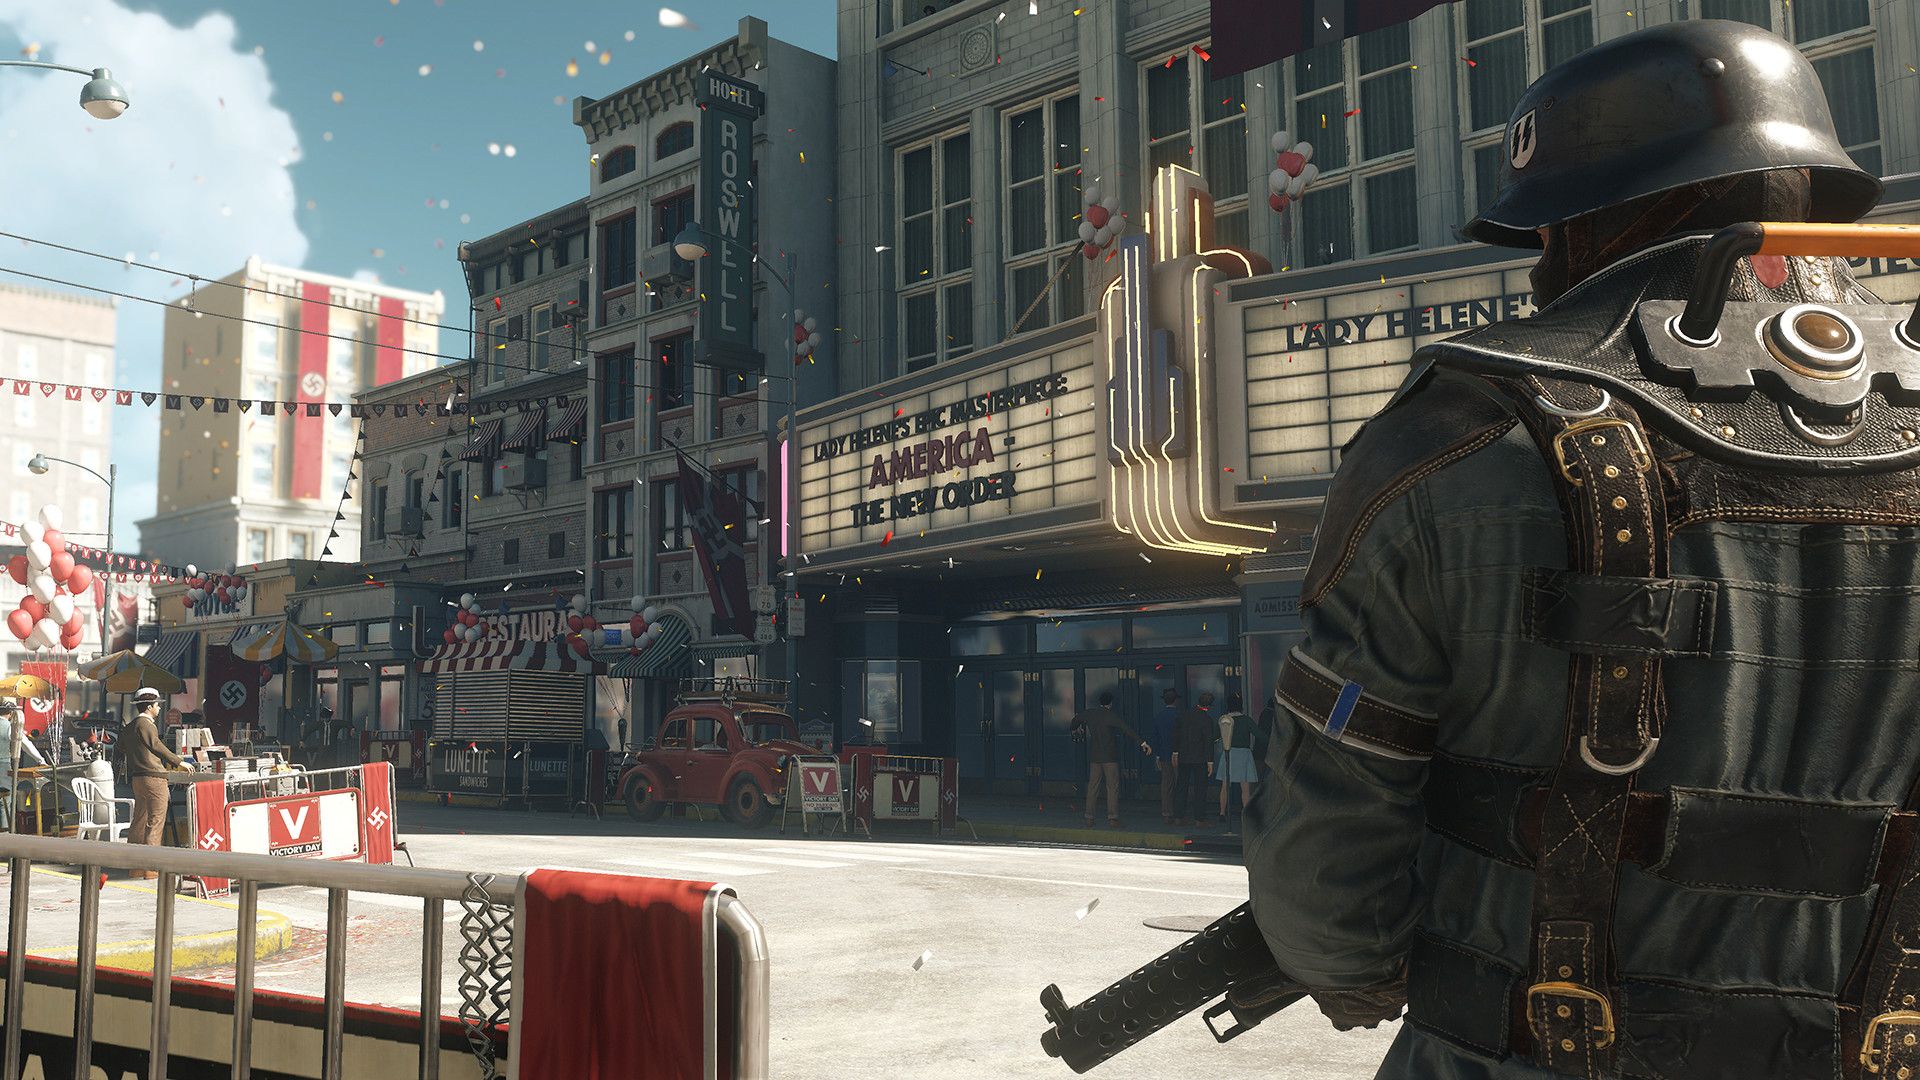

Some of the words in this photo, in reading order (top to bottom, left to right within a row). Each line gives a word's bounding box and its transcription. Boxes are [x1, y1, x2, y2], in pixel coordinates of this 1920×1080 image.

[709, 78, 754, 109] HOTEL
[717, 119, 740, 332] ROSWELL
[1286, 314, 1376, 351] LADY
[18, 383, 27, 393] V
[69, 388, 79, 398] V
[119, 394, 128, 404] V
[813, 434, 851, 463] LADY
[850, 416, 911, 452] HELENE'S
[914, 406, 947, 435] EPIC
[950, 373, 1068, 423] MASTERPIECE
[869, 427, 995, 490] AMERICA
[851, 498, 885, 528] THE
[890, 486, 939, 520] NEW
[942, 470, 1018, 510] ORDER
[386, 744, 395, 758] V
[444, 749, 489, 774] LUNETTE
[529, 760, 568, 772] LUNETTE
[809, 771, 829, 793] V
[898, 779, 914, 802] V
[279, 805, 309, 840] V
[270, 845, 304, 857] VICTORY
[305, 843, 321, 852] DAY
